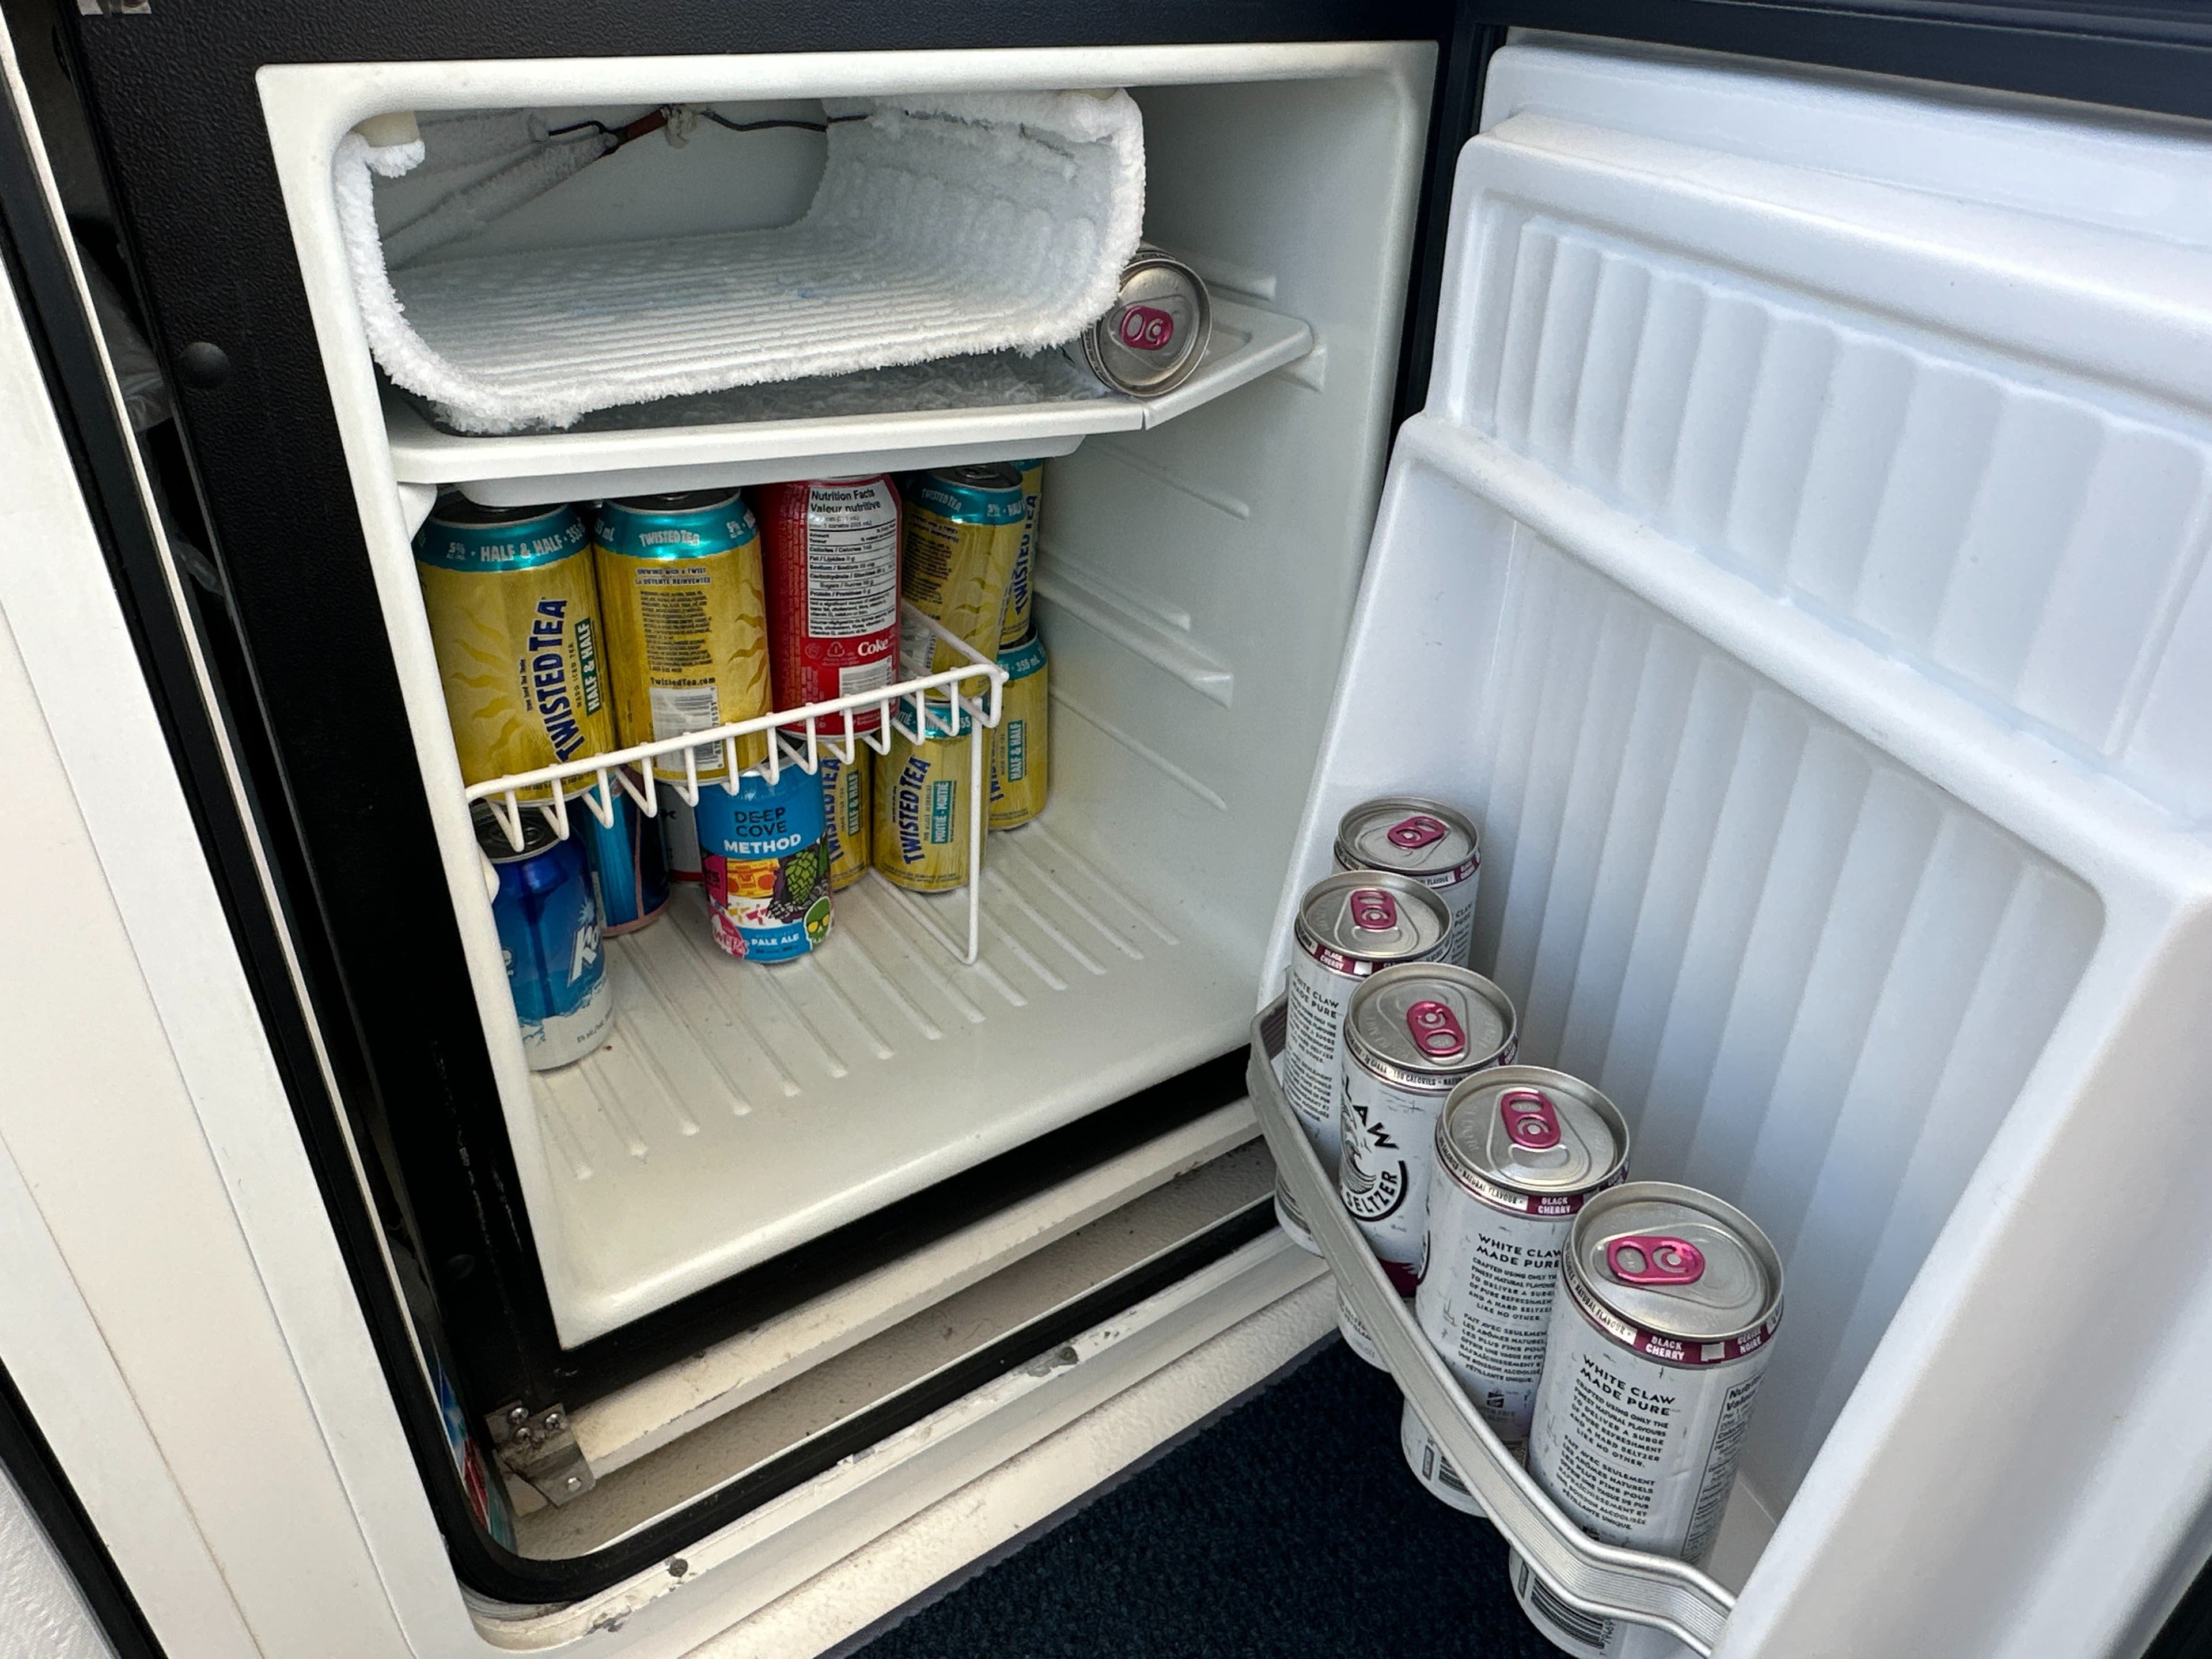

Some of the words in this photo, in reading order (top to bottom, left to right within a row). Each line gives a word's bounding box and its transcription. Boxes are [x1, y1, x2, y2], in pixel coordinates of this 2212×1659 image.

[812, 491, 851, 501] Nutrition
[853, 489, 875, 499] Facts
[811, 503, 842, 513] Valeur
[846, 501, 881, 512] nutritive
[480, 544, 516, 562] HALF
[520, 543, 531, 558] &
[532, 534, 563, 556] HALF
[639, 530, 680, 547] TWISTED
[680, 530, 700, 547] TEA
[529, 600, 567, 652] TEA
[578, 623, 593, 658] HALF
[858, 639, 888, 656] Coke
[583, 660, 594, 671] &
[586, 676, 600, 710] HALF
[533, 653, 585, 762] TWISTED
[1010, 722, 1022, 745] HALF
[900, 756, 931, 789] TEA
[1010, 757, 1022, 780] HALF
[734, 806, 786, 824] DEEP
[736, 820, 787, 837] COVE
[899, 789, 926, 865] TWISTED
[724, 834, 801, 854] METHOD
[781, 933, 799, 944] ALE
[1320, 955, 1344, 970] CHERRY
[1324, 949, 1343, 961] BLACK
[1312, 991, 1339, 1008] CLAW
[1311, 1001, 1337, 1019] PURE
[1406, 1074, 1437, 1085] CALORIES
[1345, 1169, 1398, 1214] SELTZER
[1462, 1170, 1486, 1193] NATURAL
[1488, 1188, 1517, 1205] FLAVOUR
[1537, 1205, 1571, 1214] CHERRY
[1479, 1233, 1522, 1255] WHITE
[1476, 1245, 1519, 1266] MADE
[1471, 1273, 1480, 1282] TO
[1483, 1280, 1518, 1295] DELIVER
[1494, 1276, 1524, 1287] NATURAL
[1468, 1291, 1484, 1301] AND
[1495, 1301, 1518, 1311] HARD
[1480, 1287, 1499, 1298] PURE
[1477, 1303, 1494, 1313] LIKE
[1575, 1283, 1596, 1312] NATURAL
[1596, 1309, 1626, 1335] FLAVOUR
[1463, 1321, 1475, 1331] LES
[1462, 1329, 1476, 1339] LES
[1478, 1337, 1499, 1347] PLUS
[1651, 1336, 1683, 1351] BLACK
[1740, 1336, 1763, 1354] NOIRE
[1645, 1343, 1685, 1361] CHERRY
[1584, 1354, 1626, 1390] WHITE
[1630, 1387, 1676, 1404] CLAW
[1580, 1368, 1622, 1400] MADE
[1627, 1397, 1670, 1416] PURE
[1576, 1378, 1605, 1404] CRAFTED
[1606, 1401, 1628, 1417] USING
[1630, 1414, 1651, 1425] ONLY
[1654, 1421, 1669, 1429] THE
[1573, 1395, 1582, 1406] TO
[1585, 1406, 1620, 1431] DELIVER
[1633, 1433, 1664, 1445] SURGE
[1596, 1404, 1626, 1425] NATURAL
[1627, 1422, 1666, 1437] FLAVOURS
[1595, 1433, 1618, 1448] HARD
[1621, 1446, 1660, 1461] SELTZER
[1596, 1443, 1609, 1453] NO
[1601, 1427, 1662, 1453] REFRESHMENT
[1602, 1464, 1656, 1486] SEULEMENT
[1609, 1476, 1653, 1494] NATURELS
[1599, 1480, 1620, 1493] FINS
[1624, 1490, 1651, 1502] POUR
